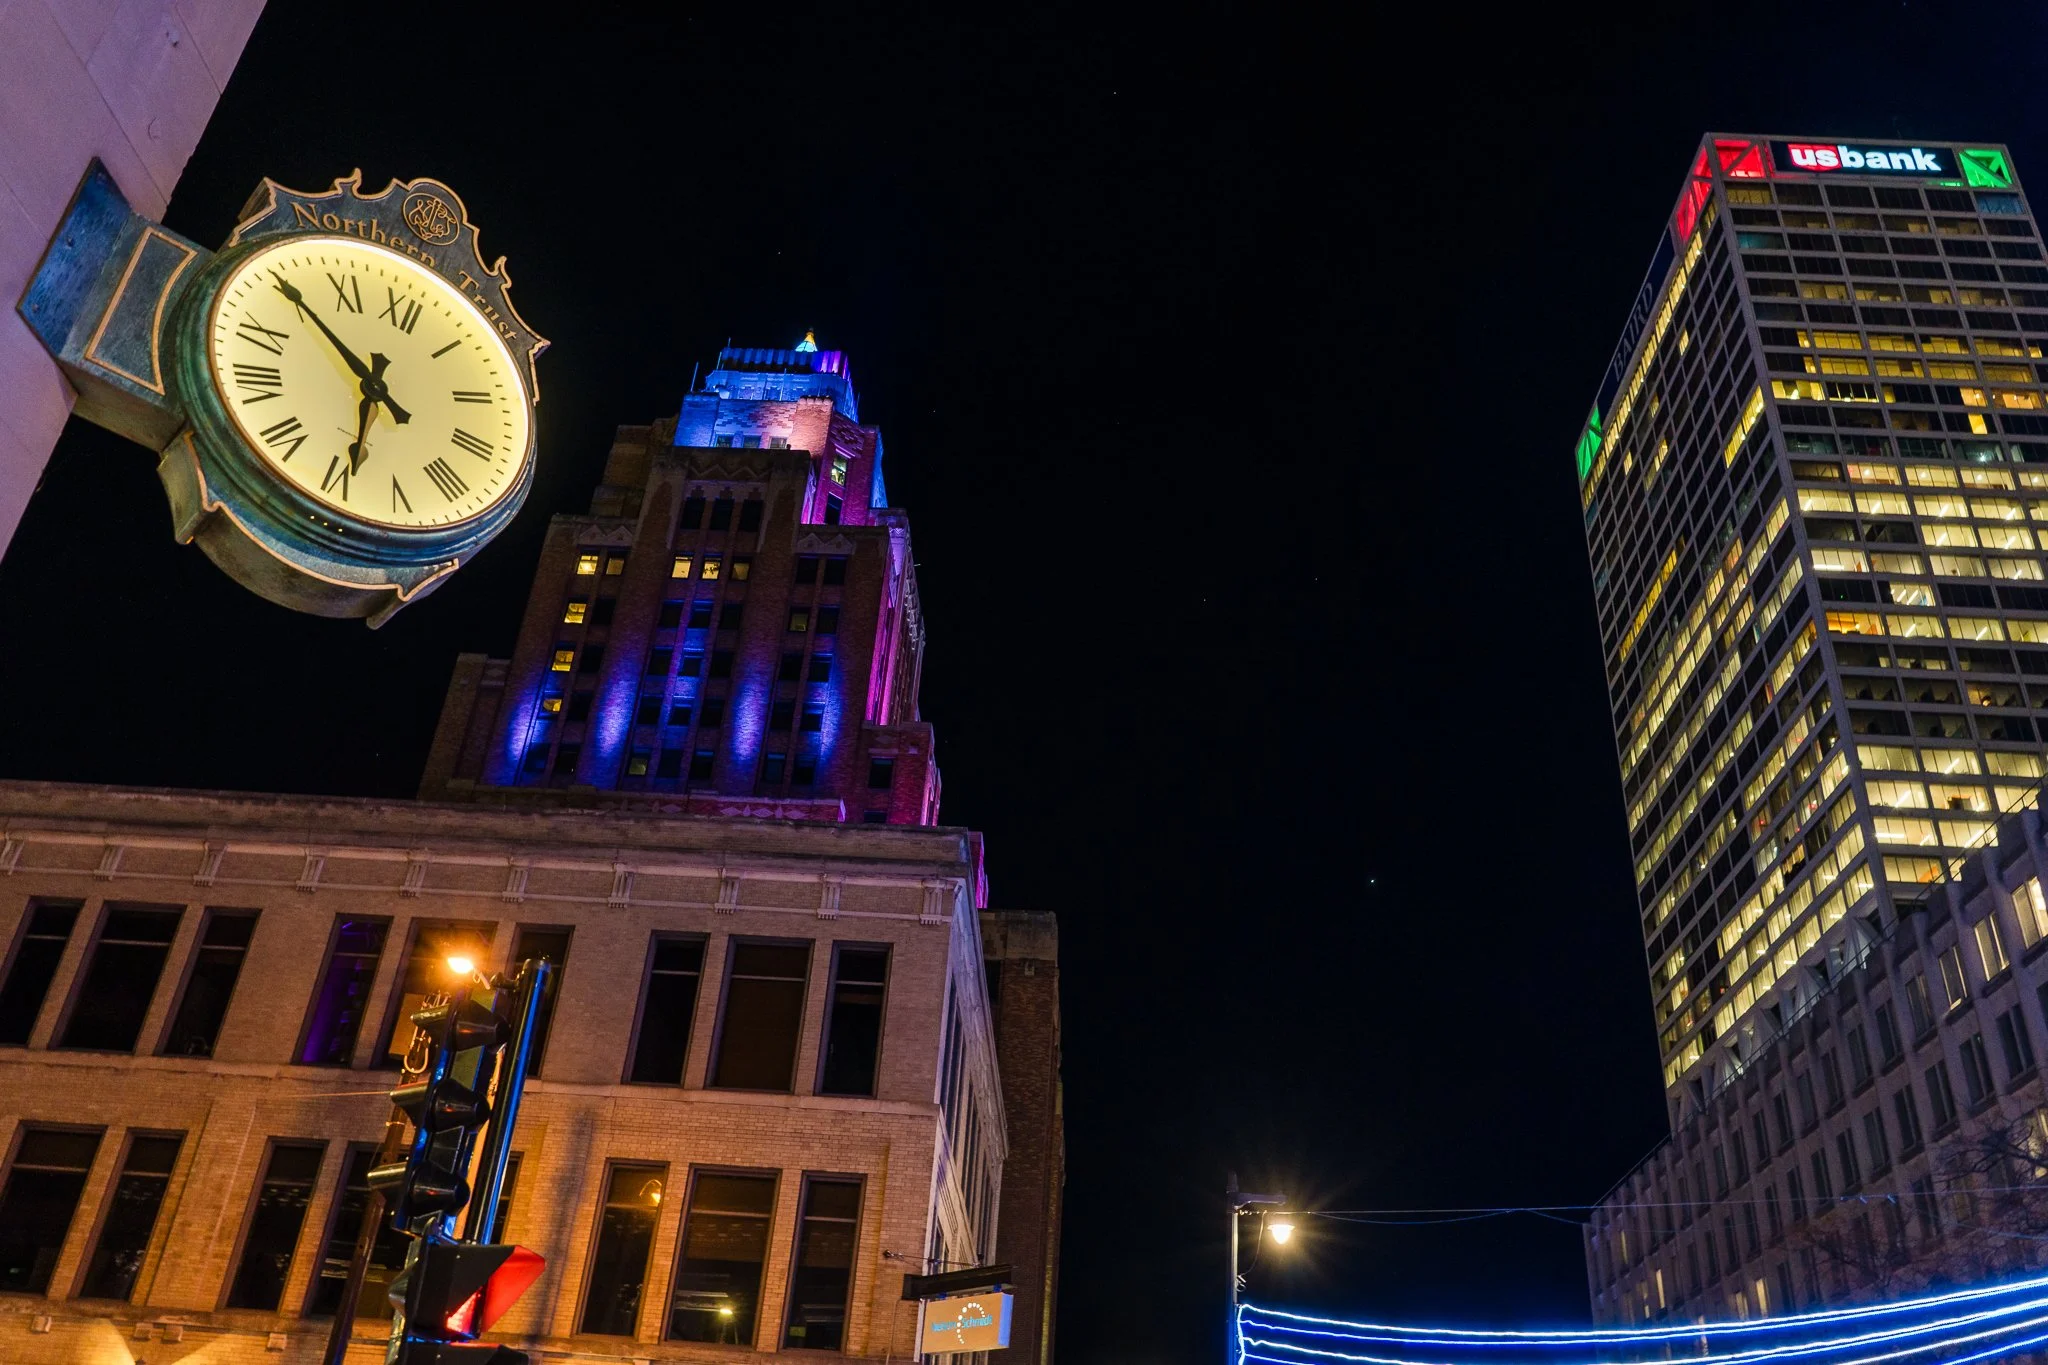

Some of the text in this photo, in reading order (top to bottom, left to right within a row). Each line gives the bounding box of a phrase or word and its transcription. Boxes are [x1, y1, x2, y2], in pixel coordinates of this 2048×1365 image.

[1792, 145, 1942, 172] usbank
[290, 201, 517, 340] Northern Trust
[326, 272, 364, 314] XI
[378, 286, 423, 335] XII
[235, 311, 290, 356] IX
[1613, 281, 1653, 383] BAIRD
[233, 363, 284, 405] VIII
[451, 390, 493, 404] II
[259, 416, 309, 463] VII
[451, 427, 495, 462] III
[320, 454, 350, 502] VI
[392, 472, 413, 514] V
